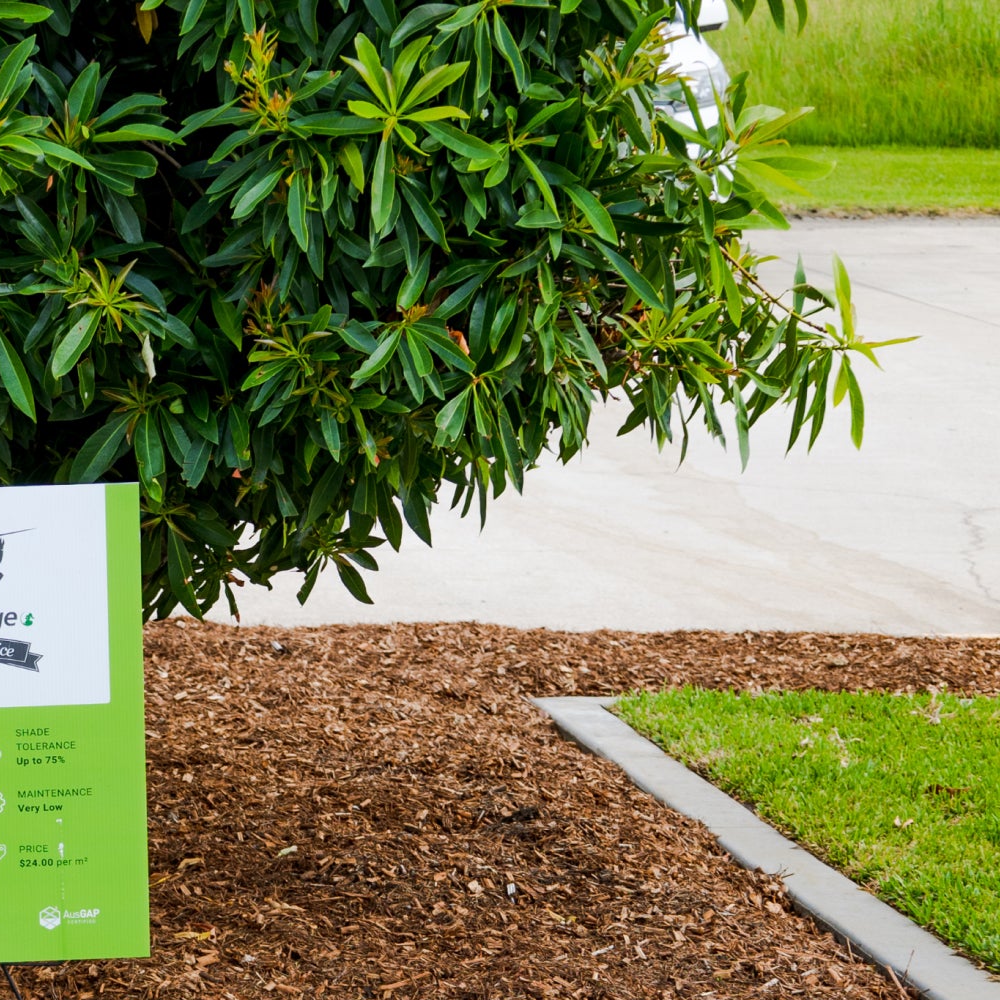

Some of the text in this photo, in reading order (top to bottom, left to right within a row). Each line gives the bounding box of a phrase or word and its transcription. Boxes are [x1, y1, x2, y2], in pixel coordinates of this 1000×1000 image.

[15, 728, 50, 737] SHADE
[16, 741, 76, 750] TOLERANCE
[16, 756, 65, 766] Up to 75%
[18, 788, 92, 798] MAINTENANCE
[18, 803, 63, 814] Very Low
[19, 844, 48, 854] PRICE
[19, 859, 53, 869] $24.00
[56, 859, 72, 868] per
[63, 908, 100, 918] AusGAP
